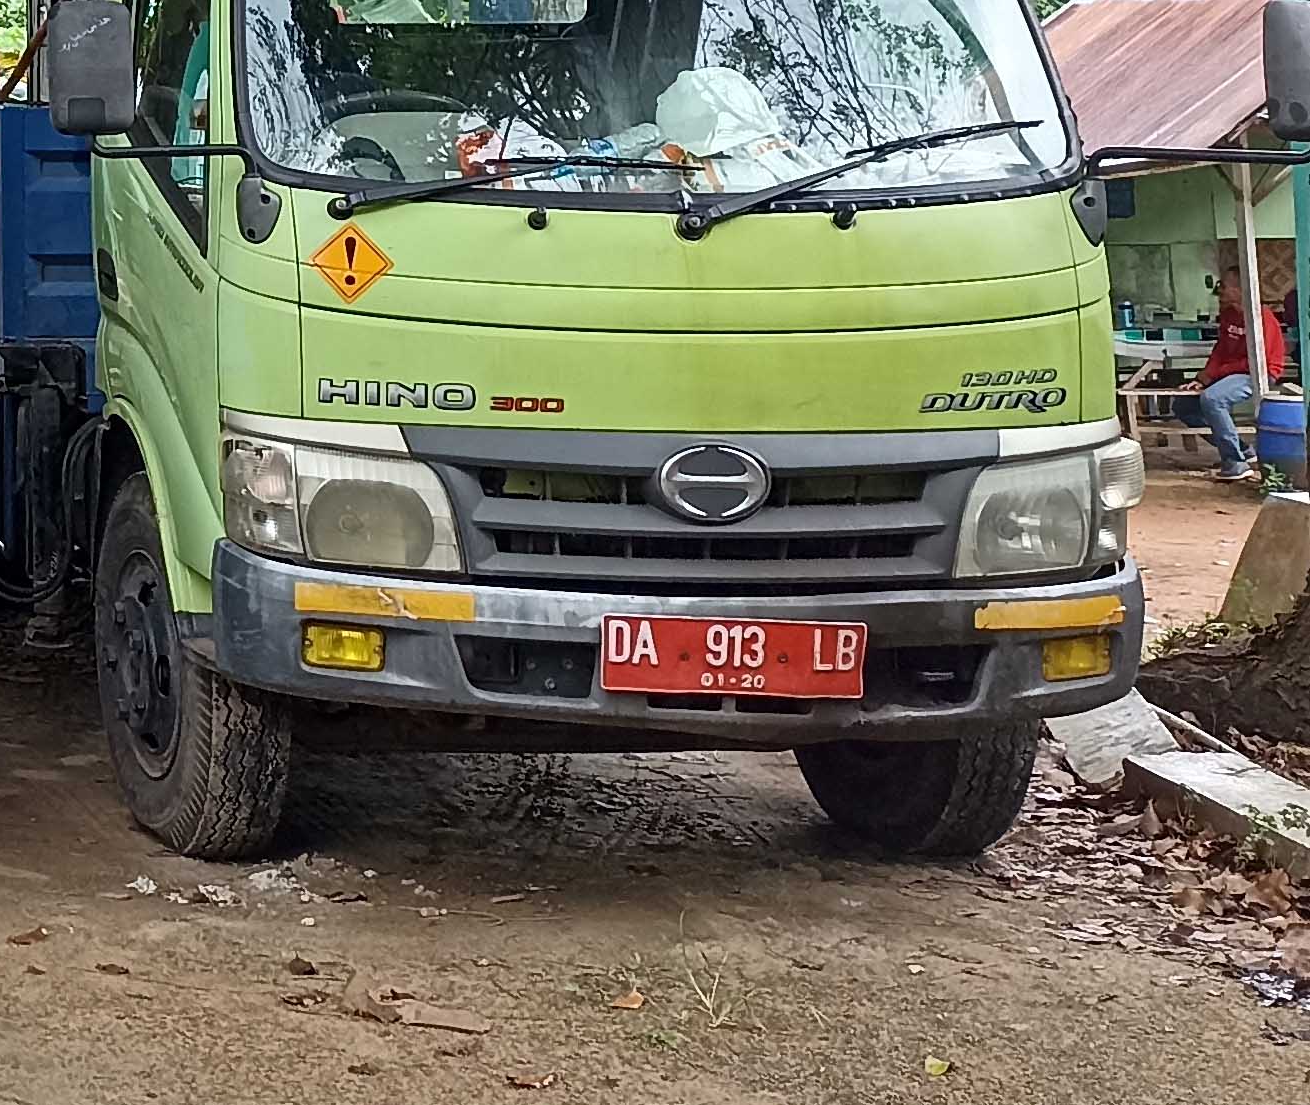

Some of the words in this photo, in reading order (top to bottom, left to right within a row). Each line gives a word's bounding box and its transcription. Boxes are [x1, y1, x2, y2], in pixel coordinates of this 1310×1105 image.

[317, 378, 477, 411] HINO
[489, 396, 565, 413] 300
[919, 387, 1067, 414] DUTRO
[607, 619, 659, 666] DA
[704, 624, 767, 668] 913
[812, 628, 859, 672] LB
